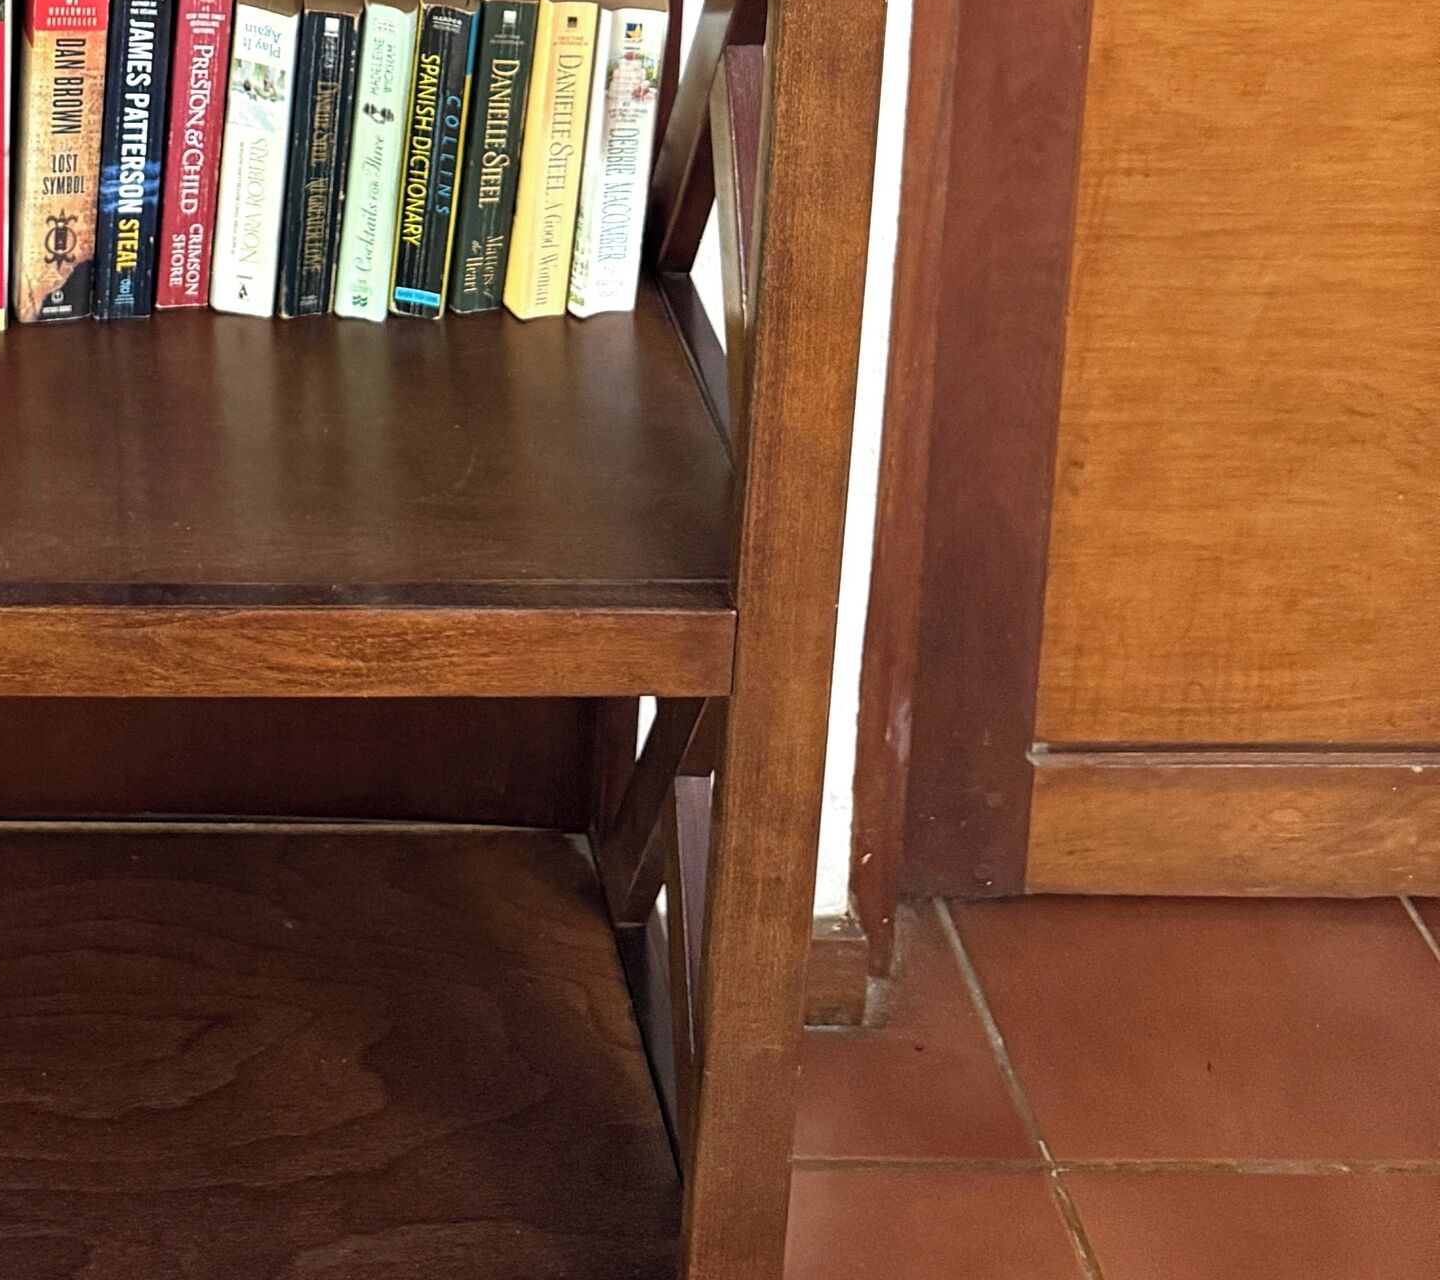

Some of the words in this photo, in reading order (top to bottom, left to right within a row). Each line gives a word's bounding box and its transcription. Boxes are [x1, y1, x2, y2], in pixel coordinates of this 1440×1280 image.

[55, 39, 86, 70] DAN
[126, 19, 155, 87] JAMES
[51, 77, 84, 135] BROWN
[416, 53, 440, 130] SPANISH
[118, 93, 150, 214] PATTERSON
[403, 131, 434, 246] DICTIONARY
[116, 219, 139, 272] STEAL
[170, 234, 185, 287] SHORE
[186, 224, 203, 295] CRIMSON
